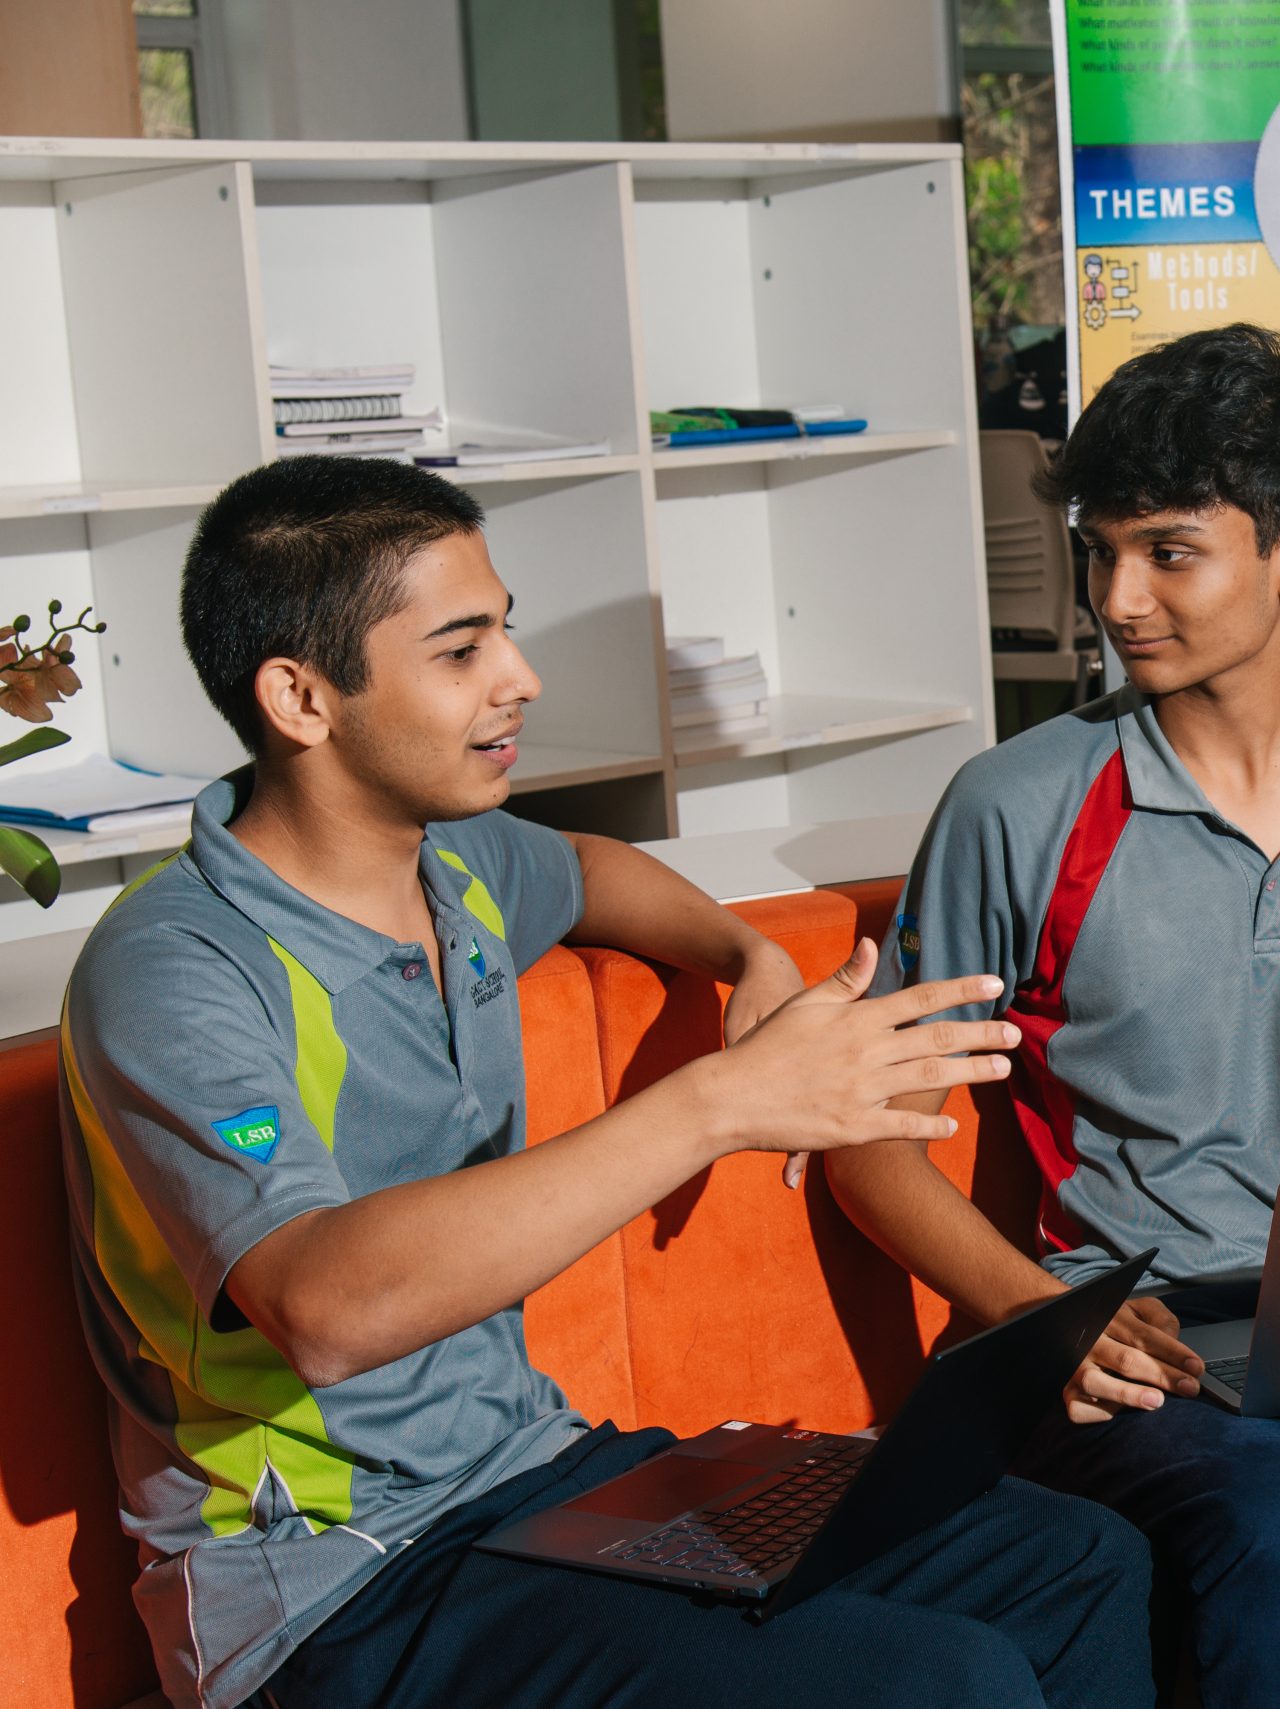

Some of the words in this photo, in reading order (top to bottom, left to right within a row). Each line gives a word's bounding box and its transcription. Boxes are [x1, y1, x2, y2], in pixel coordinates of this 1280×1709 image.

[1089, 186, 1236, 219] THEMES
[1147, 248, 1258, 280] Methods/
[1166, 281, 1229, 312] Tools
[903, 931, 920, 951] LSB
[233, 1125, 276, 1146] LSB
